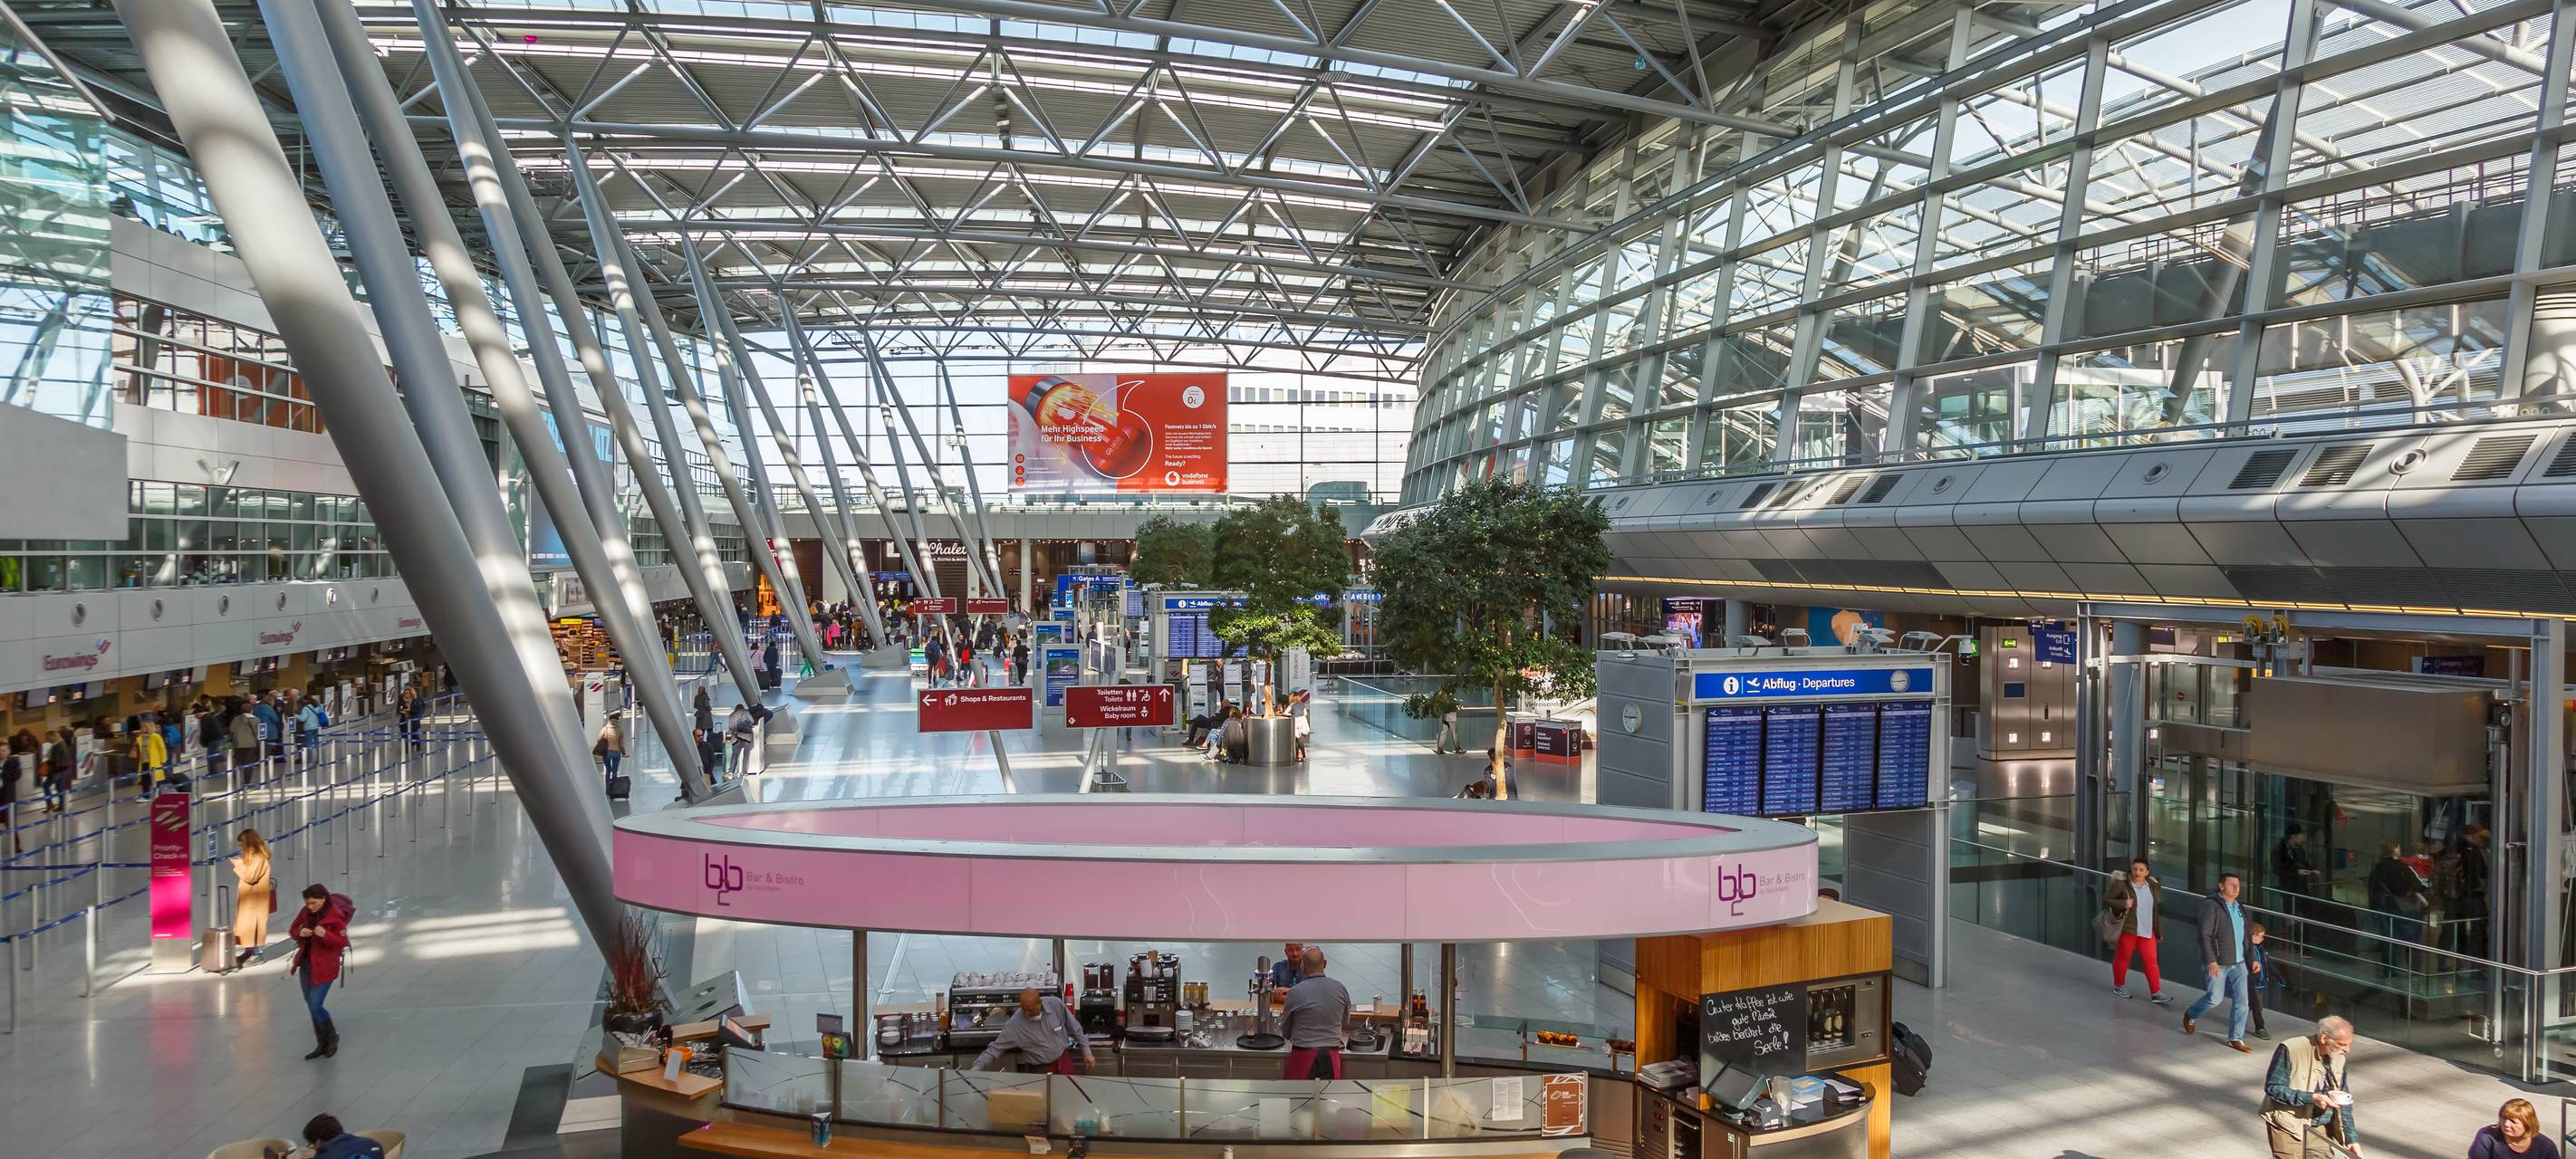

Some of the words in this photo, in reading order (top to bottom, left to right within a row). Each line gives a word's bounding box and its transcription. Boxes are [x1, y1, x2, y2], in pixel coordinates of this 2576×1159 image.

[1062, 426, 1104, 434] Highspeed
[1041, 435, 1052, 443] für
[1066, 435, 1102, 443] Business
[928, 541, 967, 555] Chalet
[43, 654, 98, 671] Eurowings
[1763, 678, 1796, 691] Abflug
[1802, 677, 1855, 690] Departures
[747, 871, 762, 882] Bar
[765, 873, 773, 883] &
[775, 873, 804, 885] Bistro
[1759, 876, 1774, 886] Bar
[1776, 874, 1782, 885] &
[1784, 872, 1806, 884] Bistro
[1735, 995, 1764, 1011] Kaffee
[1765, 993, 1777, 1006] ist
[1778, 991, 1794, 1002] wie
[1732, 1013, 1749, 1031] gute
[1768, 1022, 1782, 1033] die
